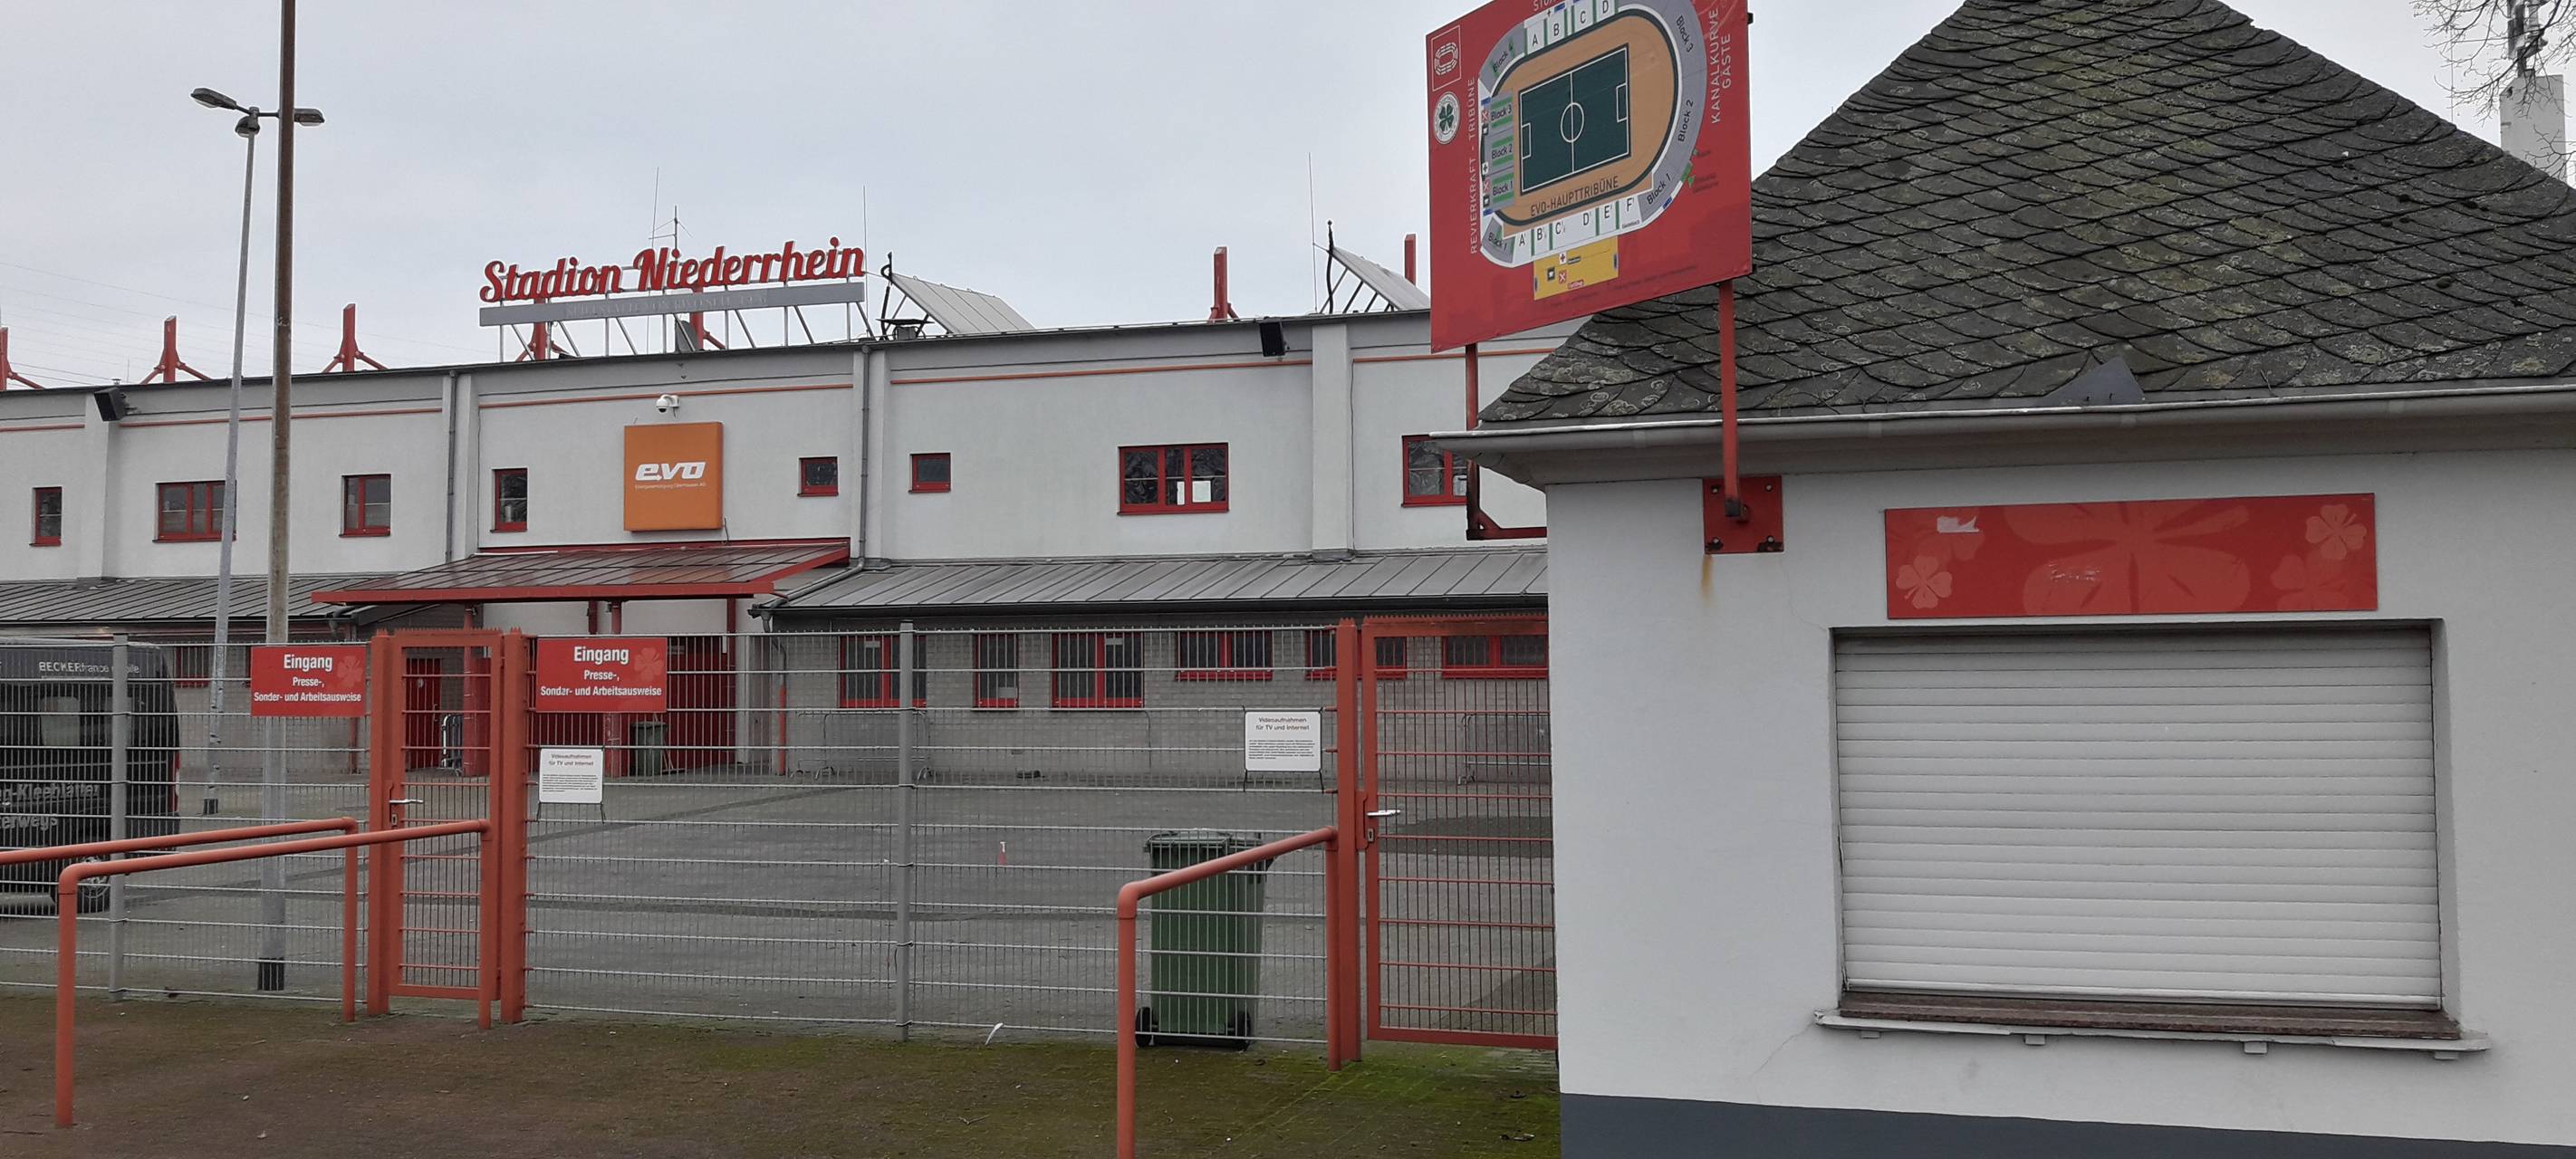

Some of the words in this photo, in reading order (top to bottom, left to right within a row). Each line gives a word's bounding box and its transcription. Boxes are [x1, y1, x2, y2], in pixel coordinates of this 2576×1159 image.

[1580, 11, 1586, 24] C
[1553, 24, 1560, 37] B
[1676, 14, 1690, 45] Block
[1686, 43, 1694, 53] 3
[1532, 34, 1539, 47] A
[1709, 7, 1720, 124] KANALKURVE
[1490, 107, 1507, 121] Block
[1507, 104, 1512, 115] 3
[1678, 110, 1692, 142] Block
[1686, 100, 1694, 108] 2
[1492, 147, 1509, 160] Block
[1508, 143, 1513, 153] 2
[1493, 183, 1510, 196] Block
[1531, 176, 1619, 216] EVO-HAUPTTRIBÜNE
[1647, 183, 1667, 205] Block
[1469, 158, 1478, 254] REVIERKRAFT
[479, 257, 626, 302] Stadion
[634, 236, 866, 292] Niederrhein
[635, 462, 706, 481] evo
[284, 654, 333, 672] Eingang
[573, 647, 630, 666] Eingang
[293, 676, 325, 688] Presse-,
[584, 669, 620, 682] Presse-,
[254, 692, 283, 702] Sonder-
[284, 692, 299, 702] und
[300, 692, 361, 702] Arbeitsausweise
[541, 685, 572, 696] Sonder-
[575, 685, 591, 696] und
[592, 685, 662, 696] Arbeitsausweise
[0, 816, 58, 831] erwegs
